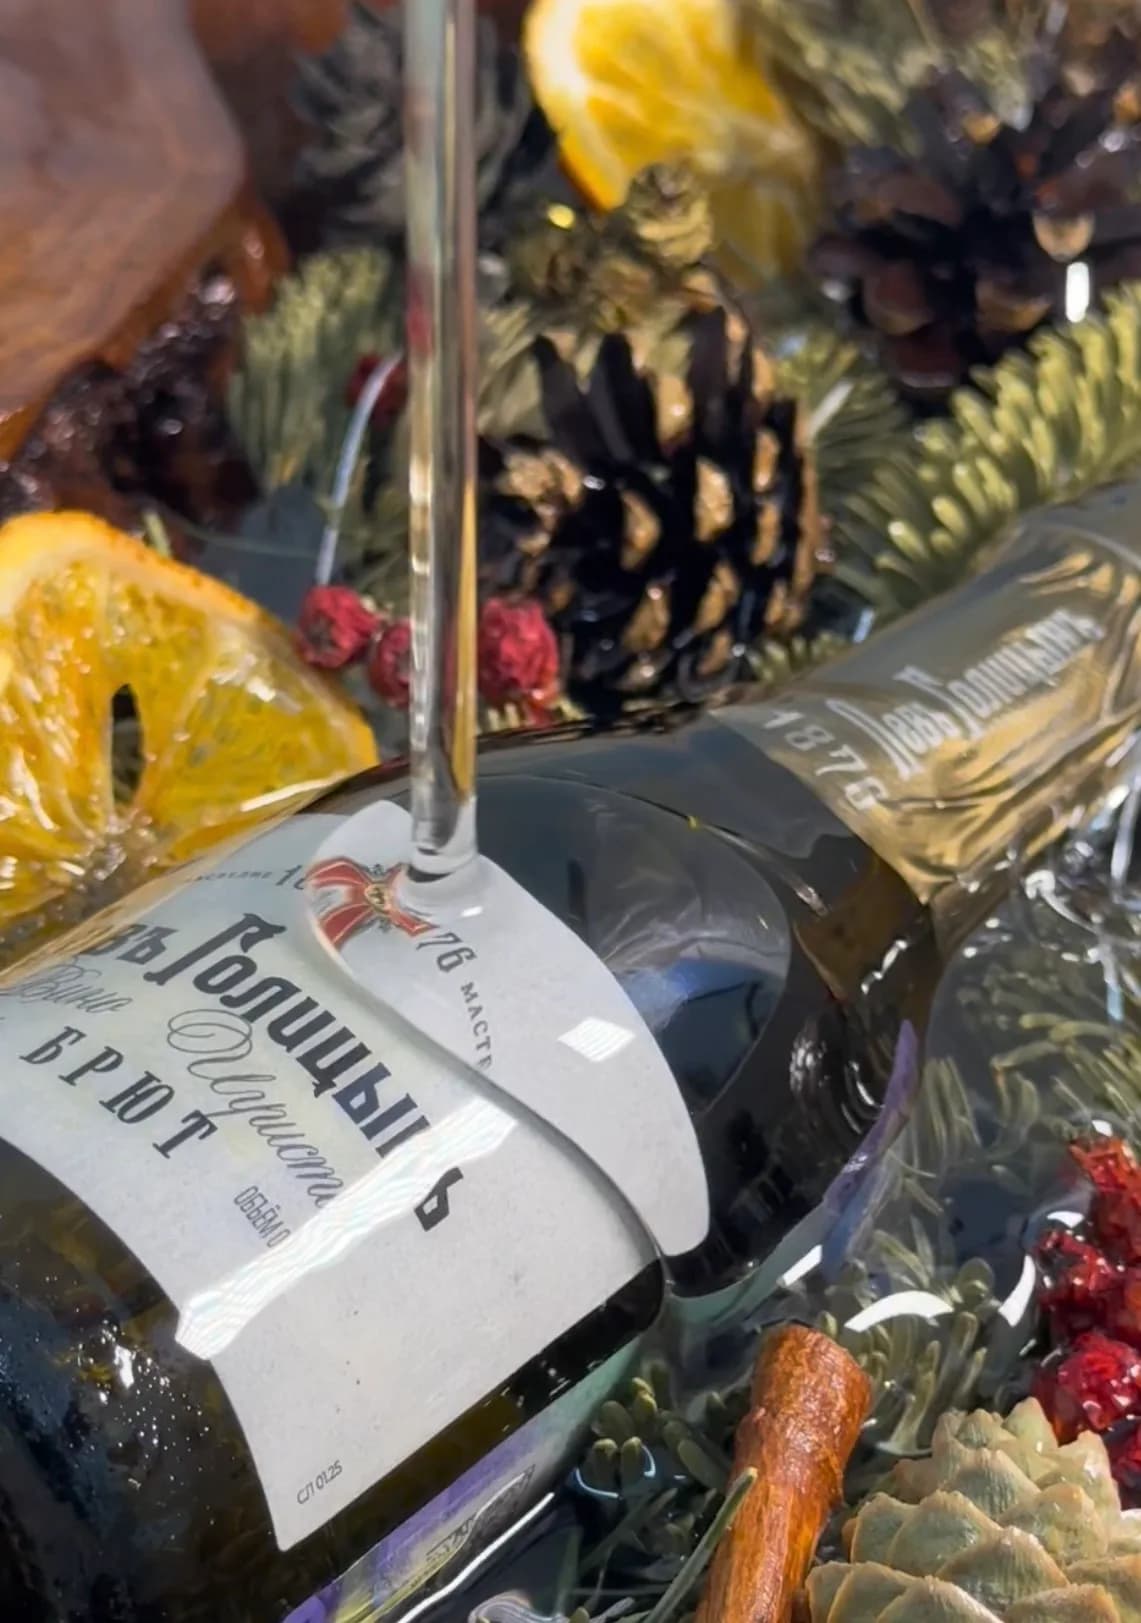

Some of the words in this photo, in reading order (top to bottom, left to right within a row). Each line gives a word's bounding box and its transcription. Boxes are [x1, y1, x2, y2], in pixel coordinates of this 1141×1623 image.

[763, 708, 889, 811] 1876
[416, 931, 478, 973] 76
[18, 1025, 218, 1160] БРЮТ
